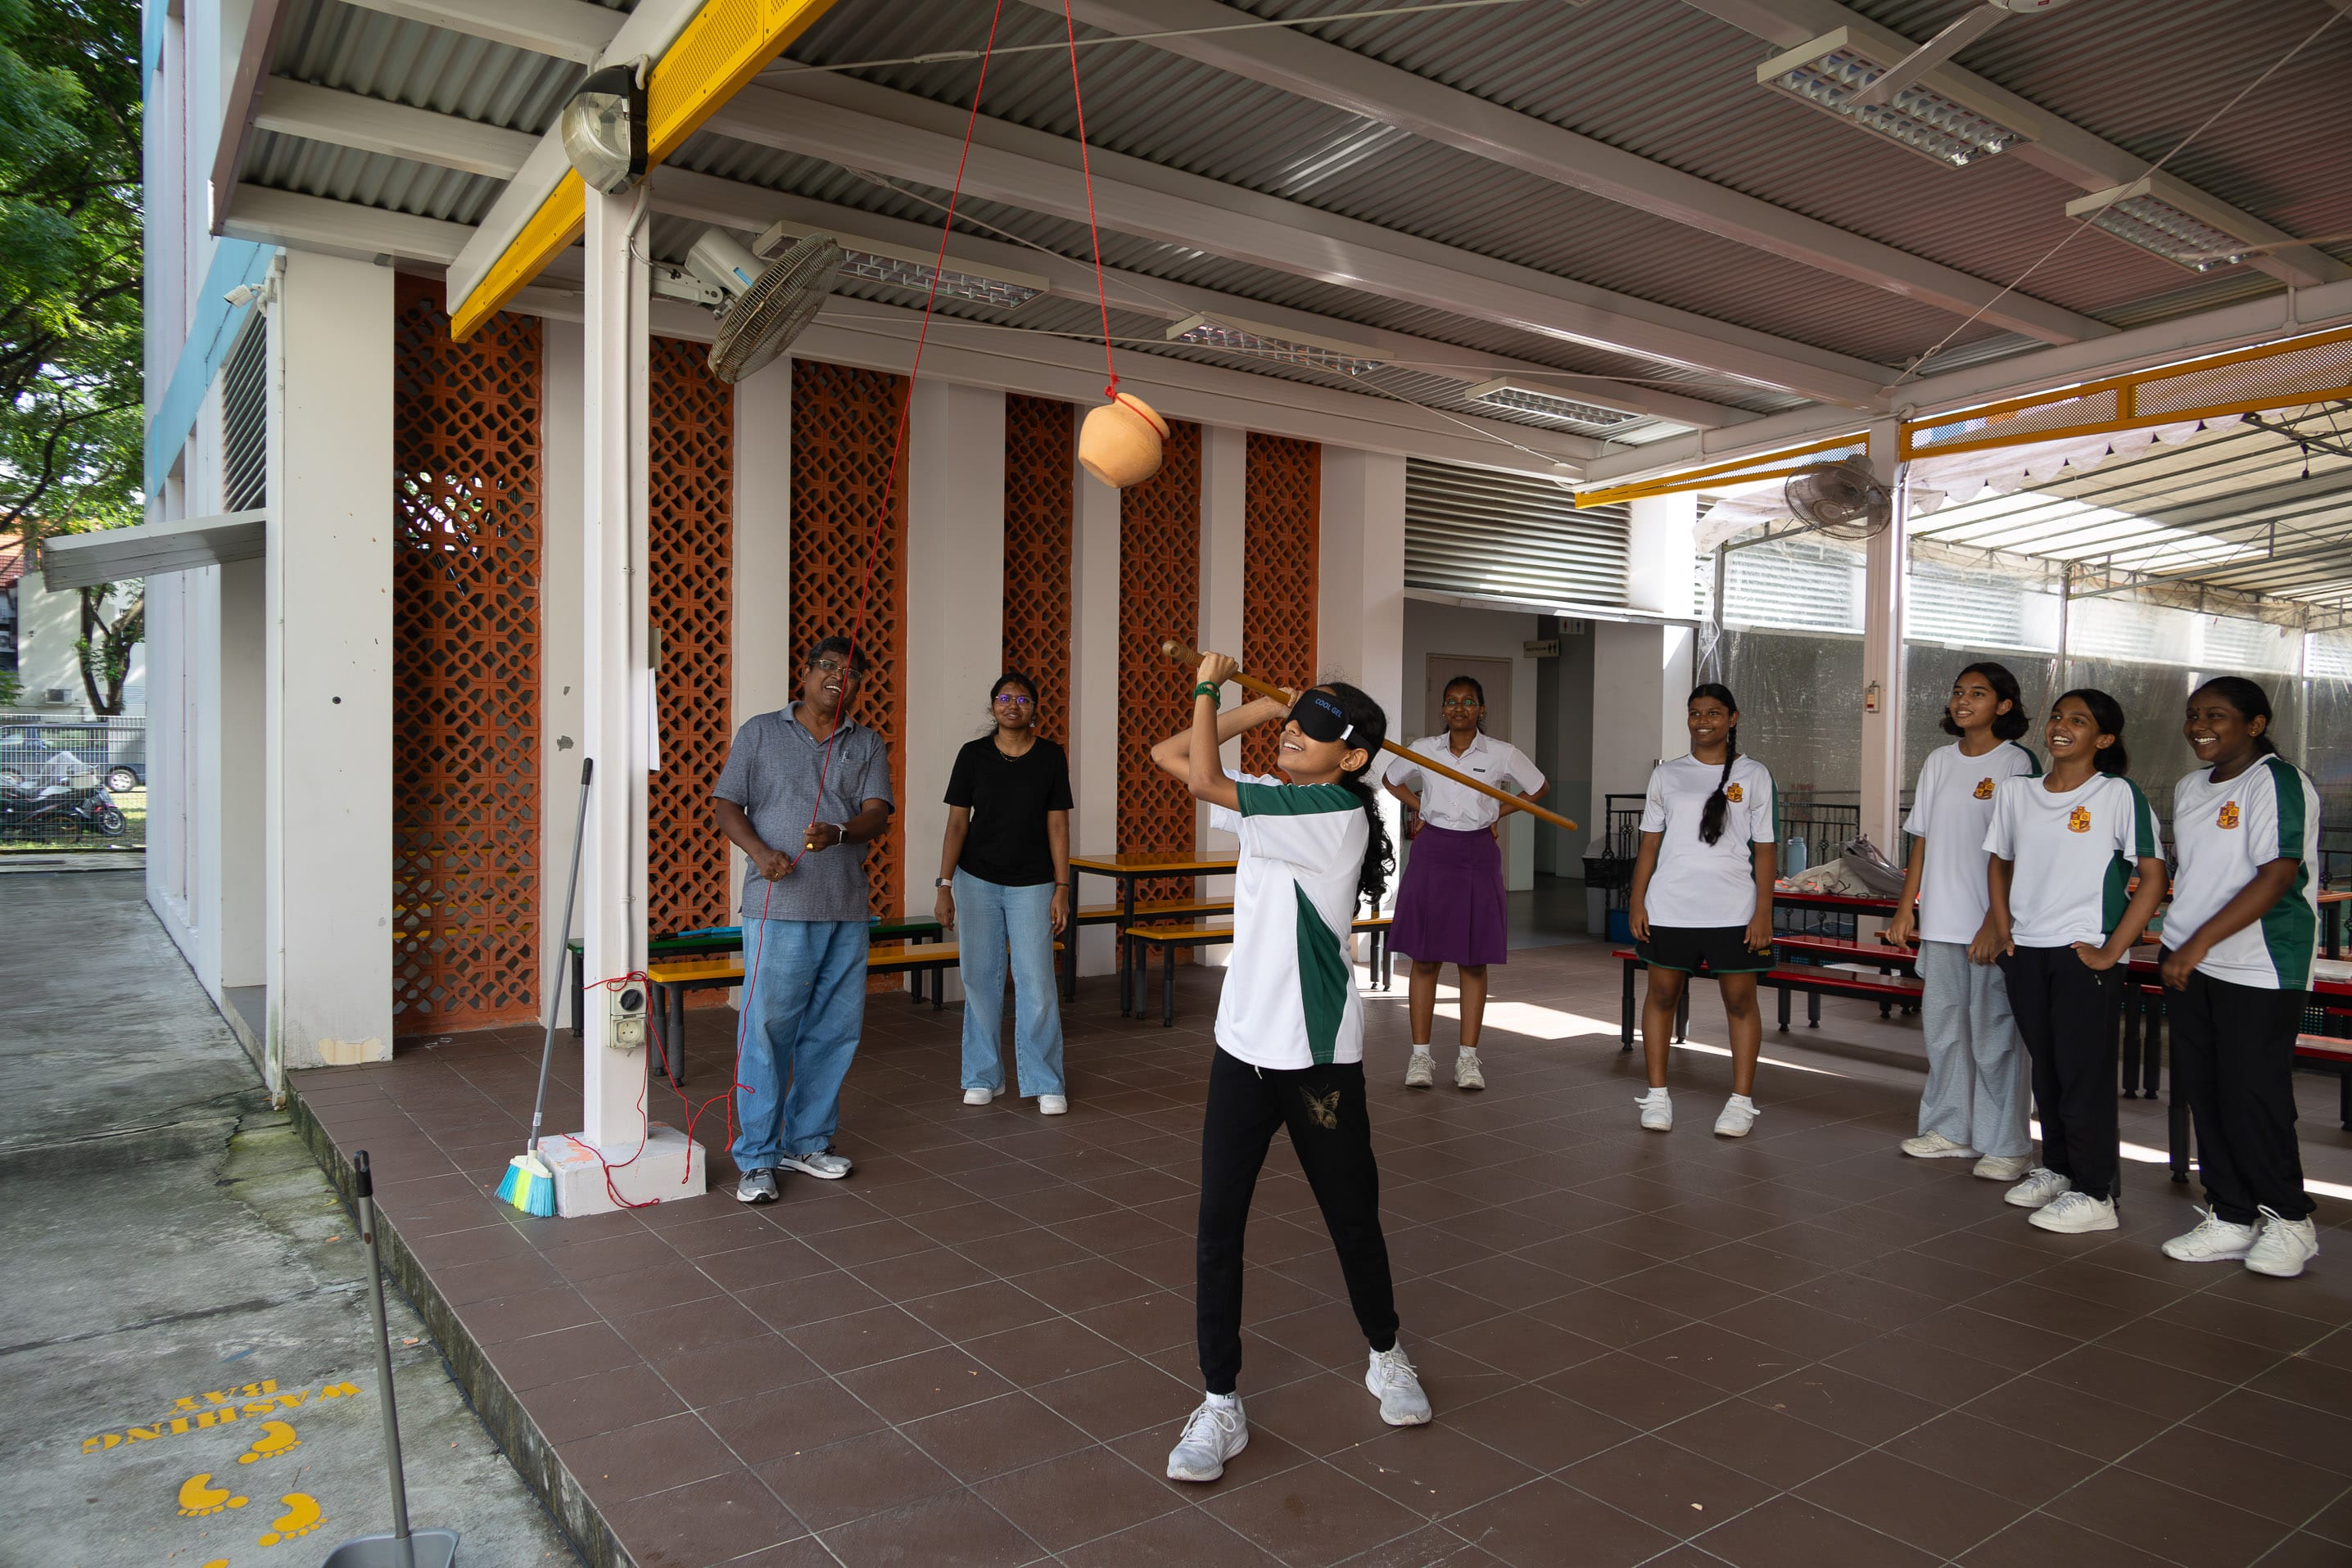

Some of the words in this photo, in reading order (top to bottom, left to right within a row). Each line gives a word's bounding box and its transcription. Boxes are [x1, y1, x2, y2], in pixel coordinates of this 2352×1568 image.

[1314, 698, 1332, 711] COOL
[1331, 707, 1343, 718] GEL
[165, 1379, 278, 1417] BAY
[81, 1380, 364, 1455] WASHING
